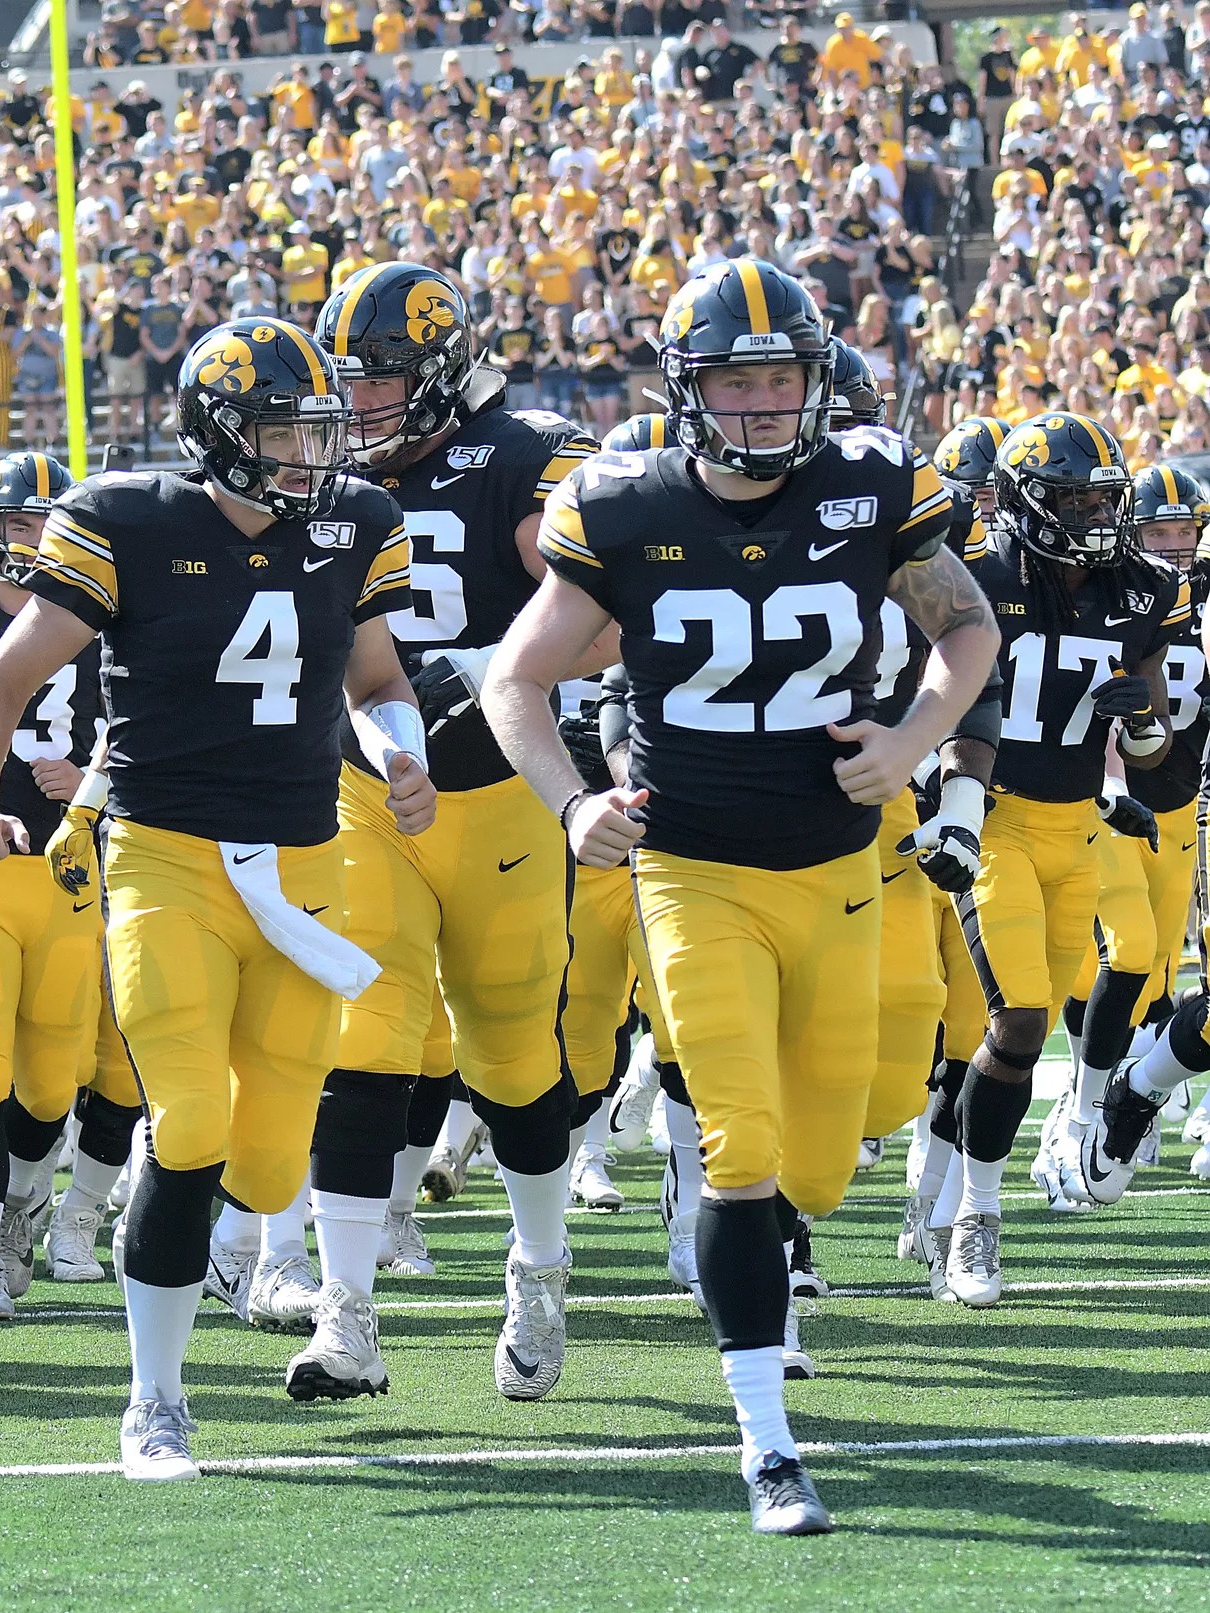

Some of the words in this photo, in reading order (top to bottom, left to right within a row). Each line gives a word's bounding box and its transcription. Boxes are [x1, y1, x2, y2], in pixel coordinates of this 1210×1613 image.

[750, 337, 775, 346] IOWA
[315, 397, 333, 405] IOWA
[446, 444, 496, 470] 150
[1101, 469, 1117, 477] IOWA
[816, 496, 878, 530] 150
[306, 521, 357, 549] 150
[215, 591, 303, 726] 4
[652, 581, 864, 733] 22
[1000, 631, 1123, 746] 17
